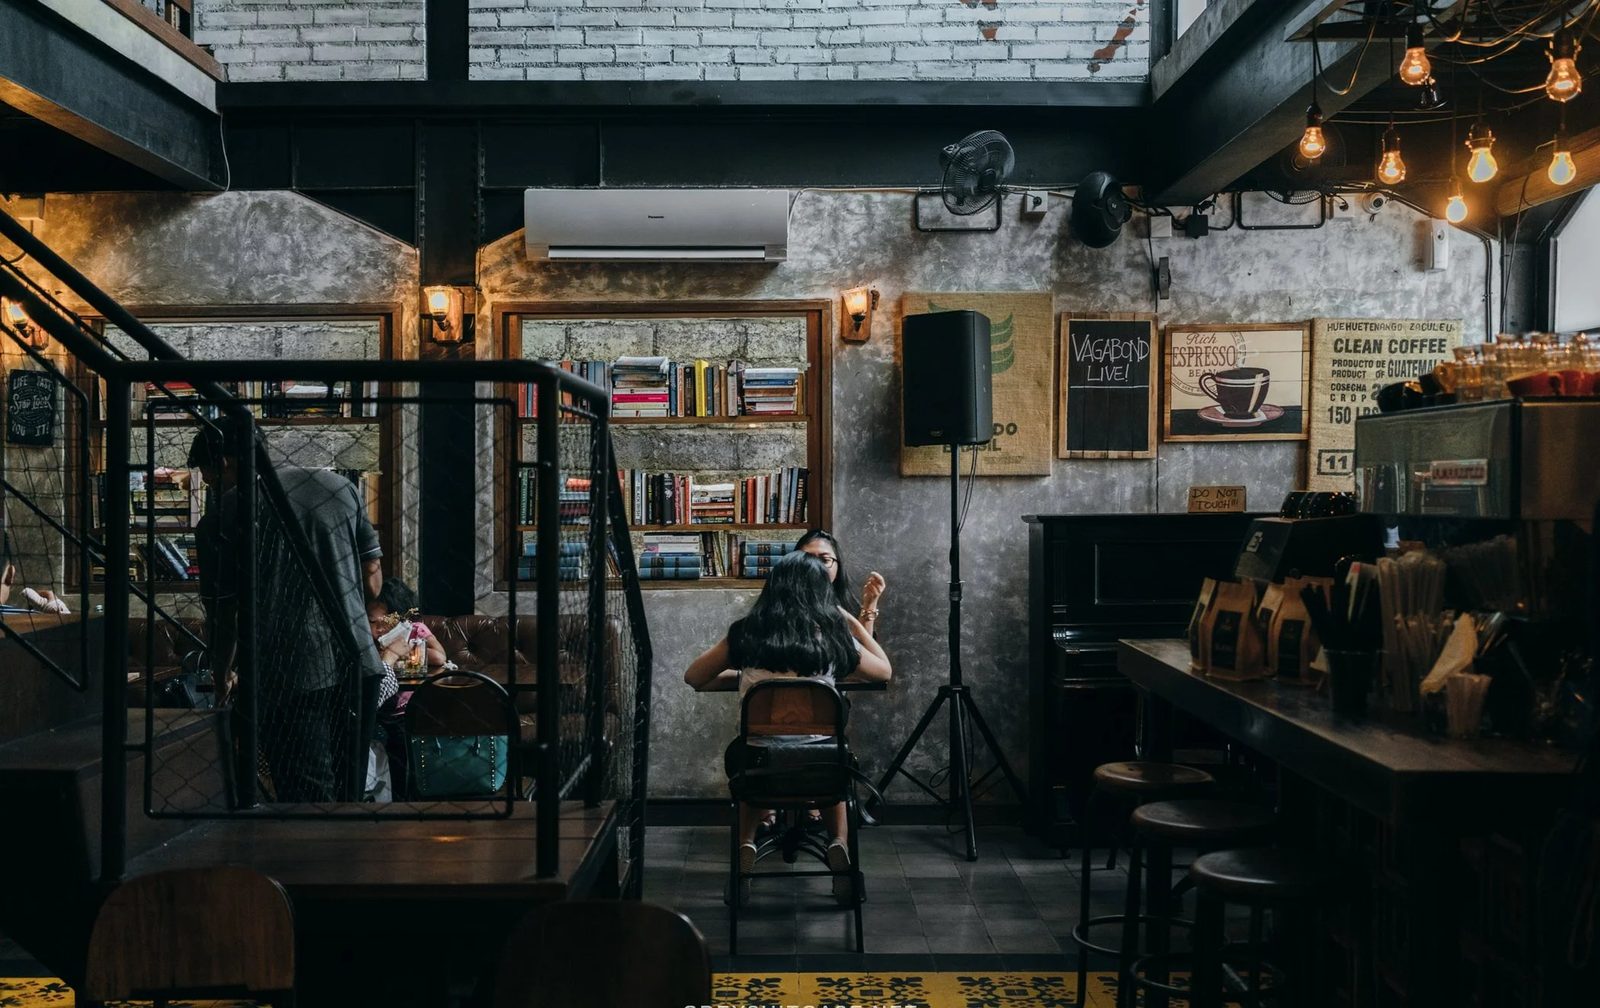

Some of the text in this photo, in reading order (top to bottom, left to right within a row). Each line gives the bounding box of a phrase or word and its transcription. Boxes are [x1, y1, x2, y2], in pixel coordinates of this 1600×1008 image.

[1186, 332, 1217, 345] Rich
[1071, 333, 1150, 363] VAGABOND
[1334, 338, 1447, 354] CLEAN COFFEE
[1172, 346, 1236, 367] ESPRESSO
[1332, 359, 1386, 369] PRODUCTO DE
[1087, 363, 1129, 383] LIVE!
[1189, 368, 1219, 378] BEAN
[1331, 369, 1386, 379] PRODUCT OF
[1330, 382, 1367, 392] COSECHA
[1327, 405, 1351, 424] 150
[992, 422, 1018, 436] DO
[1325, 455, 1347, 470] 11
[1191, 488, 1244, 499] DO NOT
